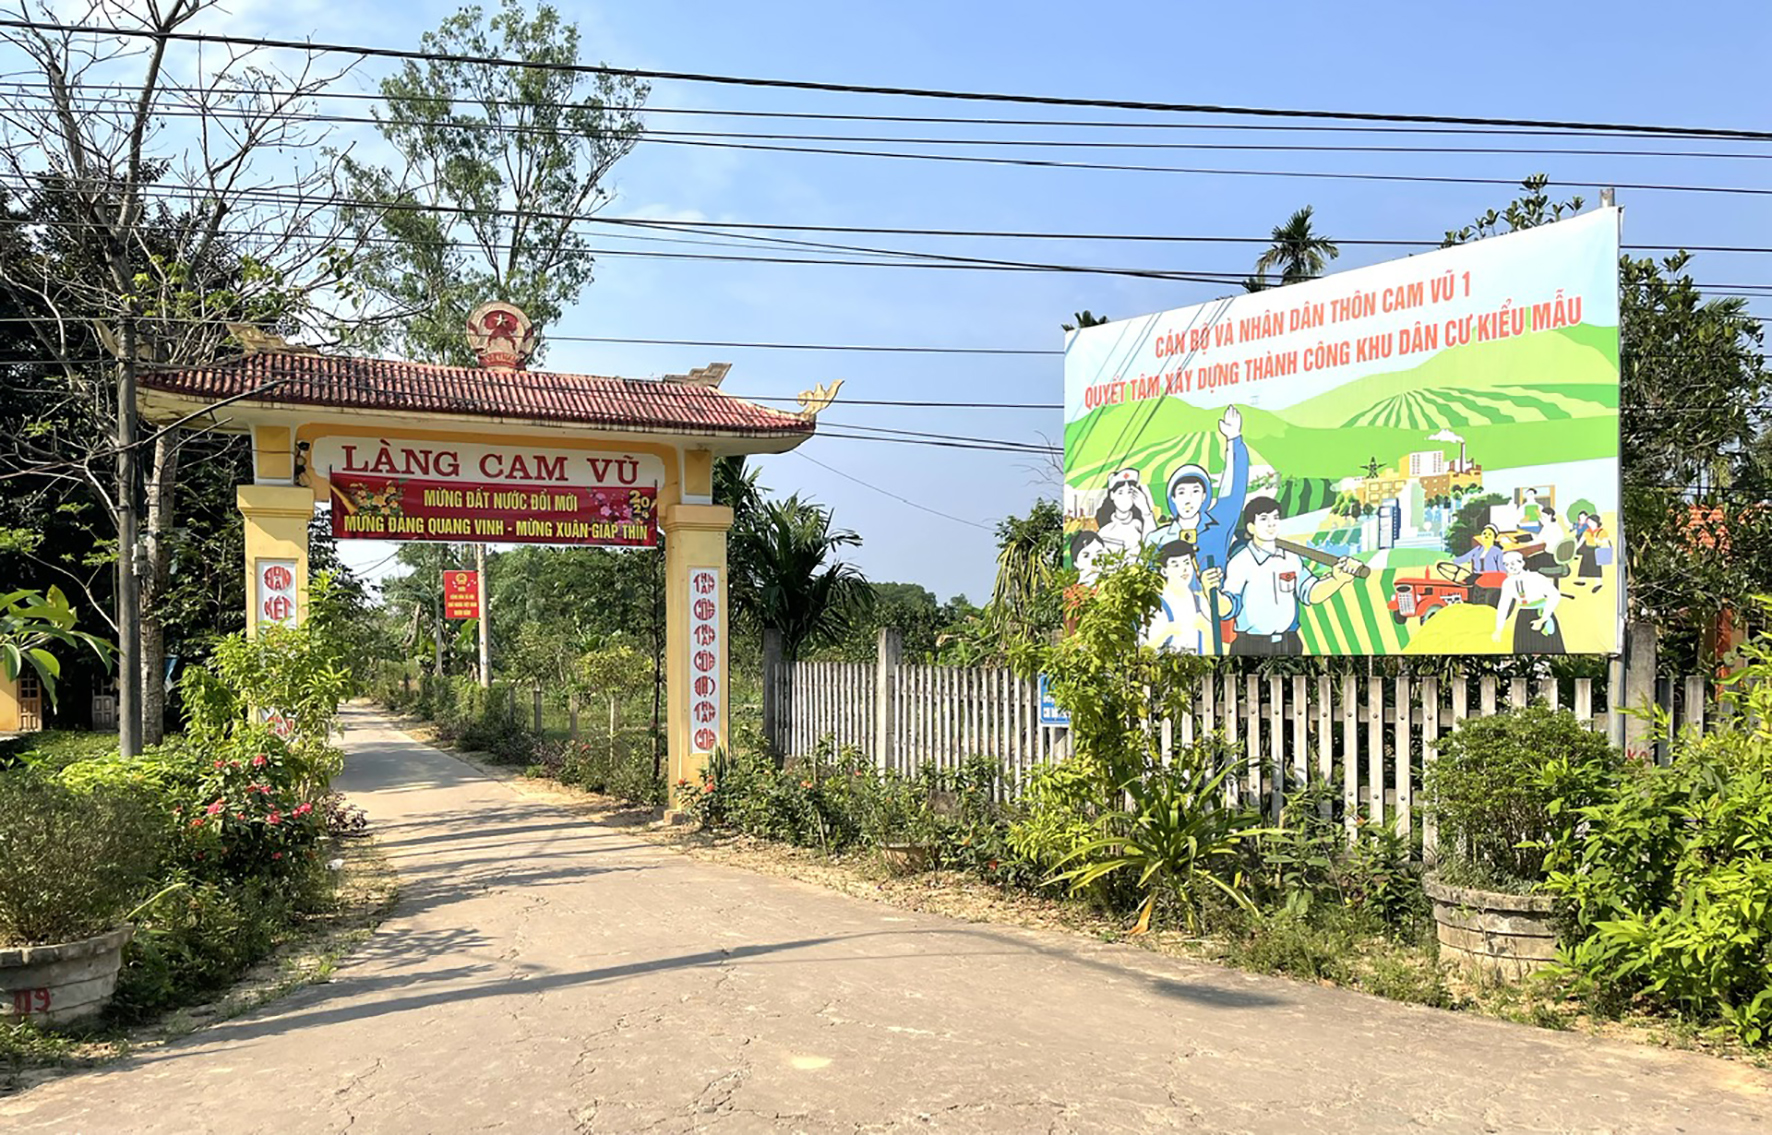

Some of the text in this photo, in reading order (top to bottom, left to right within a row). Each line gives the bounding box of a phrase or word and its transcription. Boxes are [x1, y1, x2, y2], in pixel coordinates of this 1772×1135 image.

[1155, 269, 1470, 358] CÁN BỘ VÀ NHÂN DÂN THÔN CAM VŨ 1
[1085, 374, 1127, 410] QUYẾT
[1130, 373, 1161, 401] TÂM
[1197, 361, 1239, 394] DỰNG
[1245, 351, 1298, 382] THÀNH
[1303, 341, 1350, 372] CÔNG
[1356, 332, 1393, 363] KHU
[1399, 320, 1438, 355] DÂN
[1445, 313, 1473, 347] CƯ
[1477, 298, 1525, 342] KIỂU
[1532, 288, 1582, 331] MẪU
[341, 438, 640, 485] LÀNG CAM VŨ
[424, 486, 578, 512] MỪNG ĐẤT NƯỚC ĐỔI MỚI
[387, 511, 424, 533] ĐẢNG
[428, 517, 471, 535] QUANG
[474, 519, 504, 536] VINH
[515, 517, 553, 537] MỪNG
[556, 519, 589, 538] XUÂN
[264, 595, 291, 621] KẾT
